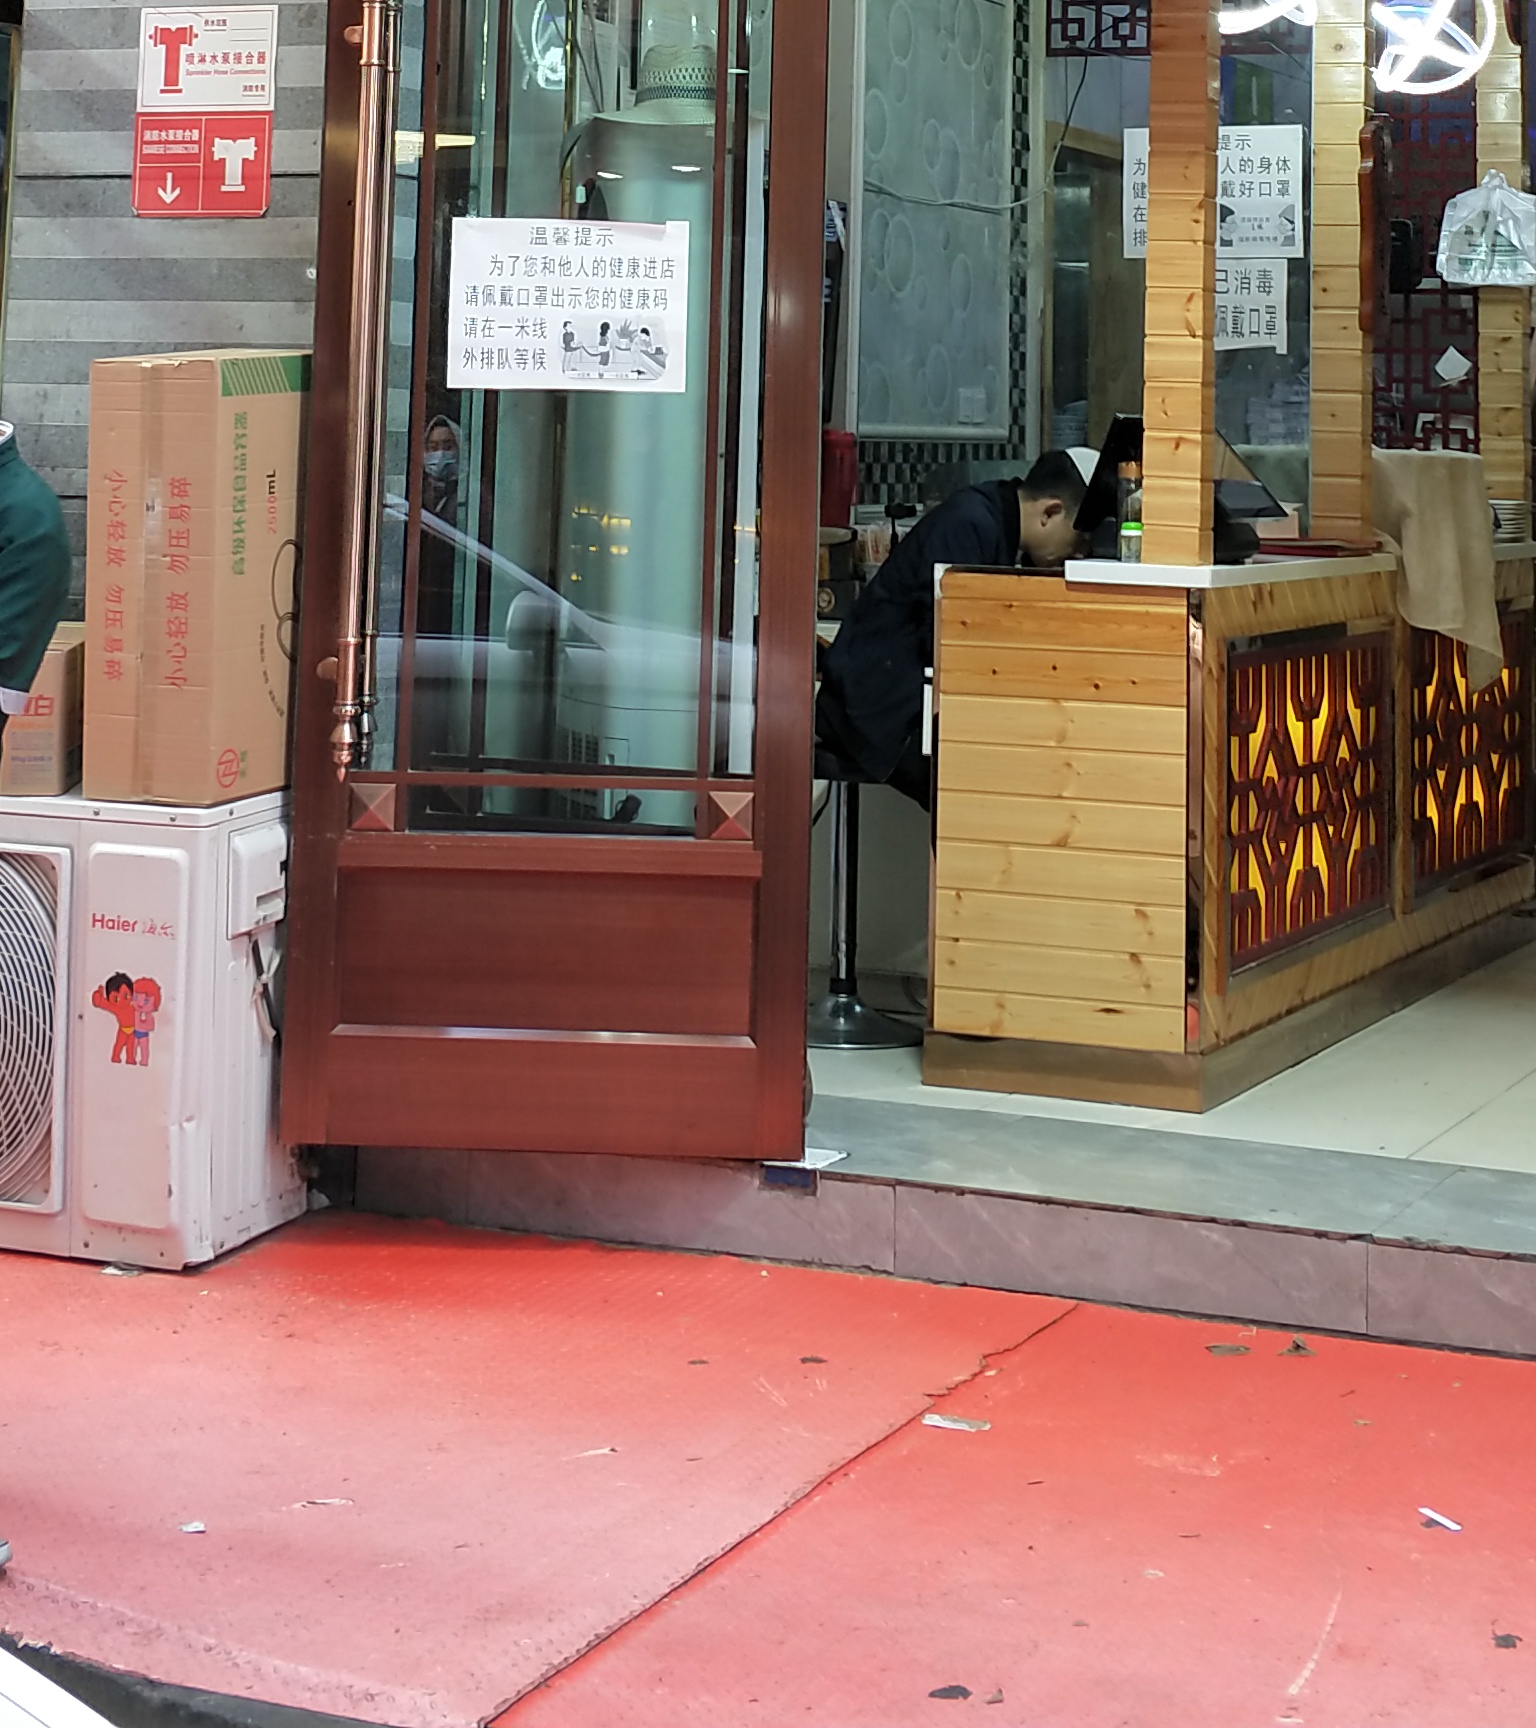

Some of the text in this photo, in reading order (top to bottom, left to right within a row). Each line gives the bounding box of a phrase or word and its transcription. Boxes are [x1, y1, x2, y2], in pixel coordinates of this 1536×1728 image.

[1221, 156, 1291, 175] 人的身体
[1220, 179, 1292, 198] 戴好口罩
[529, 226, 615, 247] 温馨提示
[489, 255, 676, 280] 为了您和他人的健康进店
[464, 285, 668, 311] 请佩戴口罩出示您的健康码
[463, 316, 548, 340] 请在一米线
[462, 347, 548, 371] 外排队等候
[106, 470, 128, 569] 小心轻放
[163, 476, 193, 690] 小心轻放 勿压易碎
[92, 913, 138, 932] Haier
